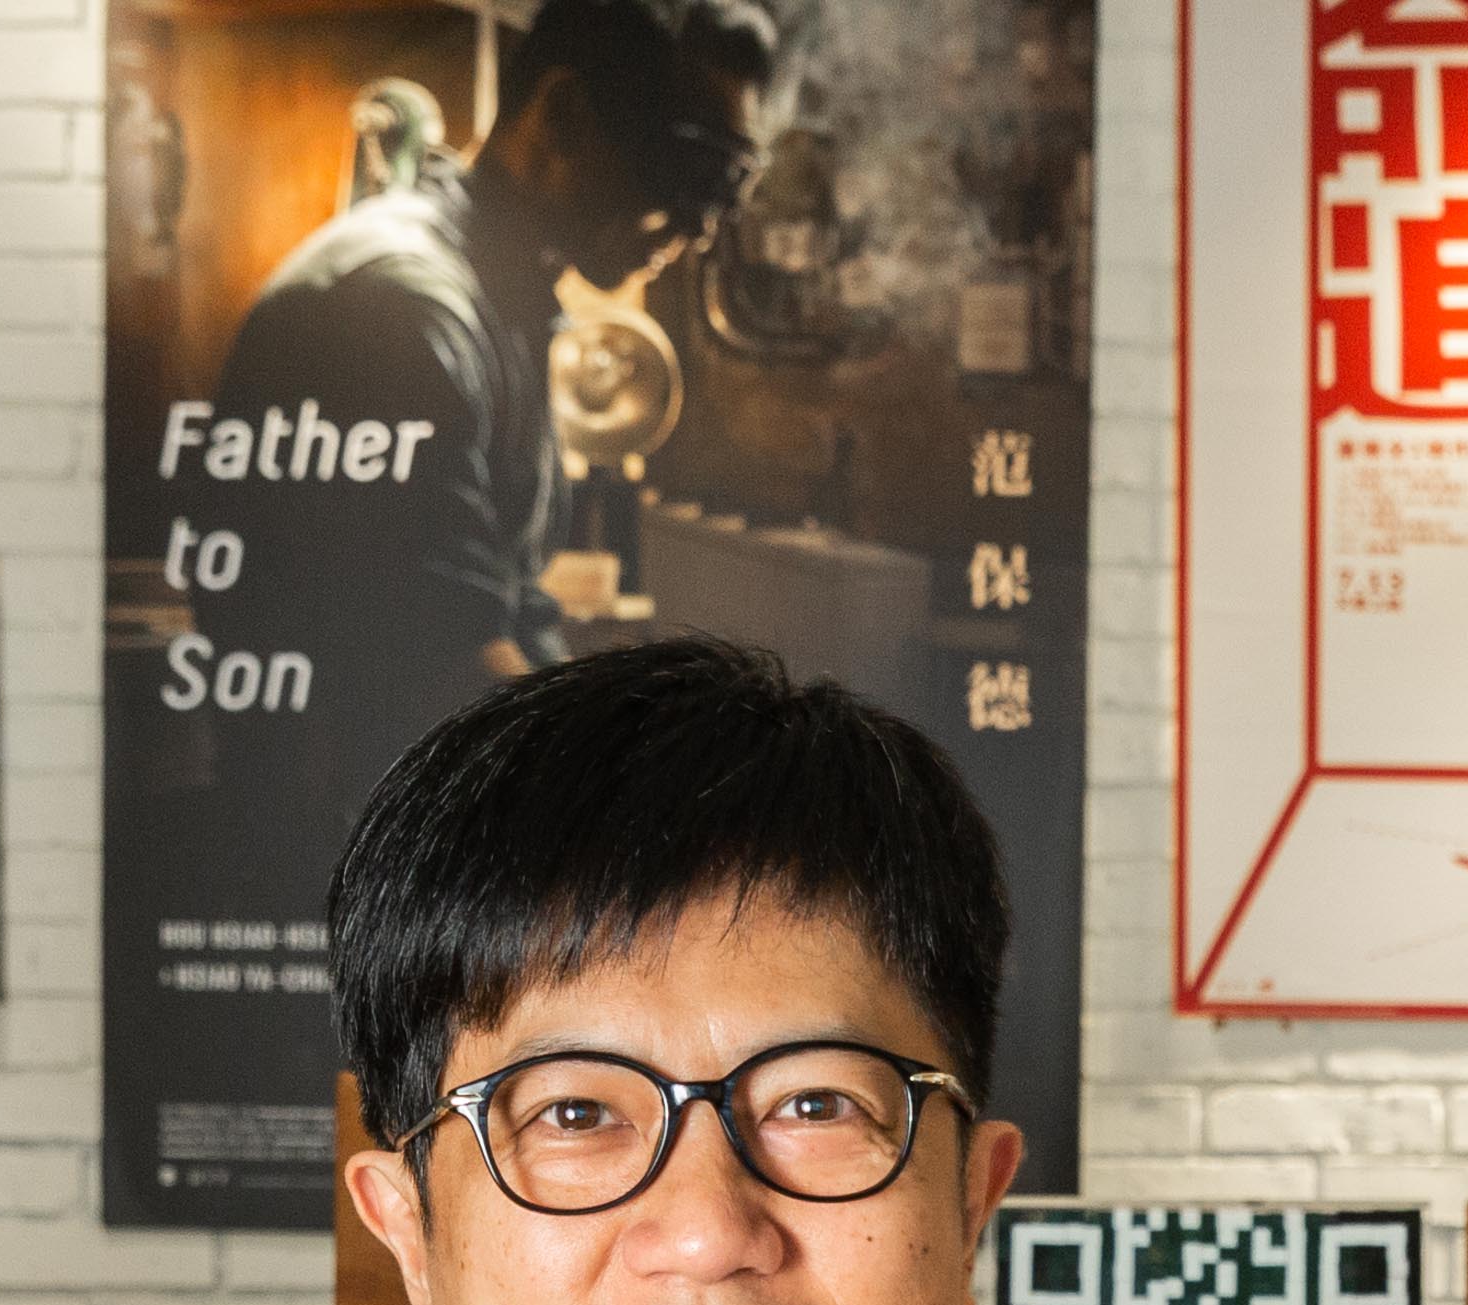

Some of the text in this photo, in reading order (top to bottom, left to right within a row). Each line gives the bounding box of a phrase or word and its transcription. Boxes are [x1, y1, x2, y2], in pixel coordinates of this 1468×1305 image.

[159, 398, 434, 484] Father
[164, 515, 244, 592] to
[160, 633, 313, 715] Son
